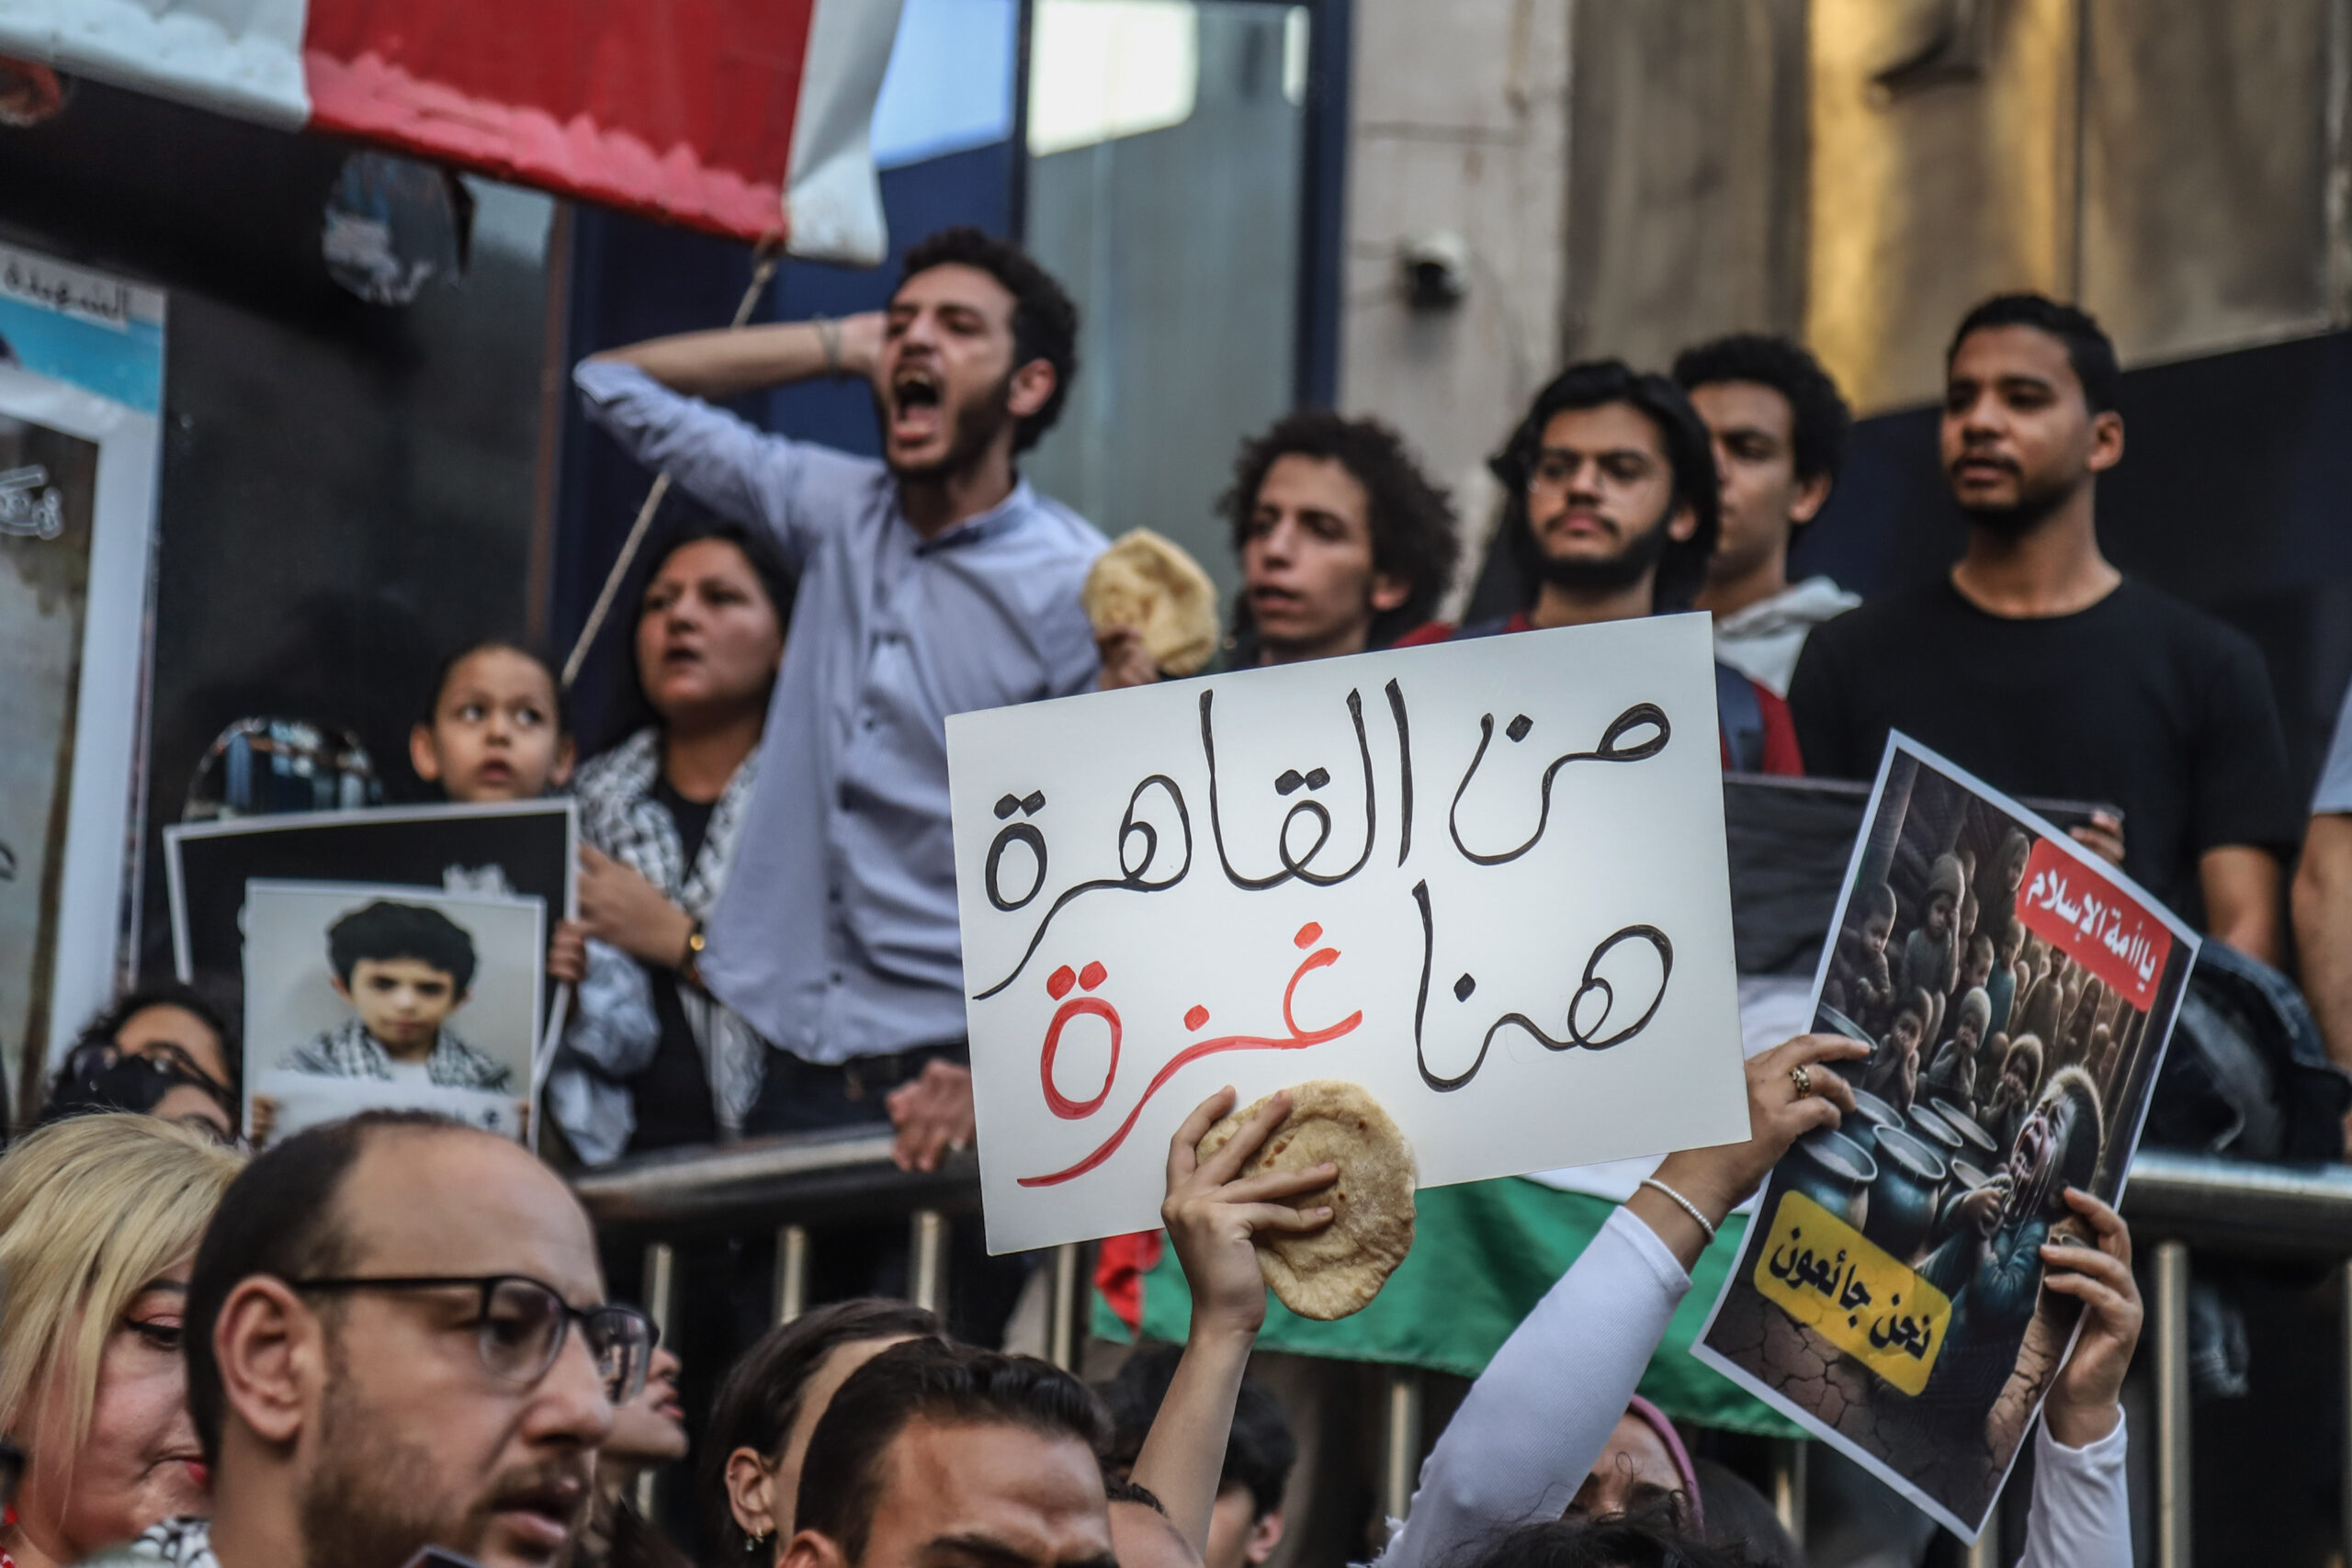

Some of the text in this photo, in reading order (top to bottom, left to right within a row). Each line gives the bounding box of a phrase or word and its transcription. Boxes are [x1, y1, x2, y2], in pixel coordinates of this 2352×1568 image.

[971, 677, 1672, 1001] من القاهرة
[2025, 868, 2108, 942] الإسلام
[1017, 878, 1674, 1188] هنا غزة
[1769, 1226, 1931, 1361] نحن جائعون
